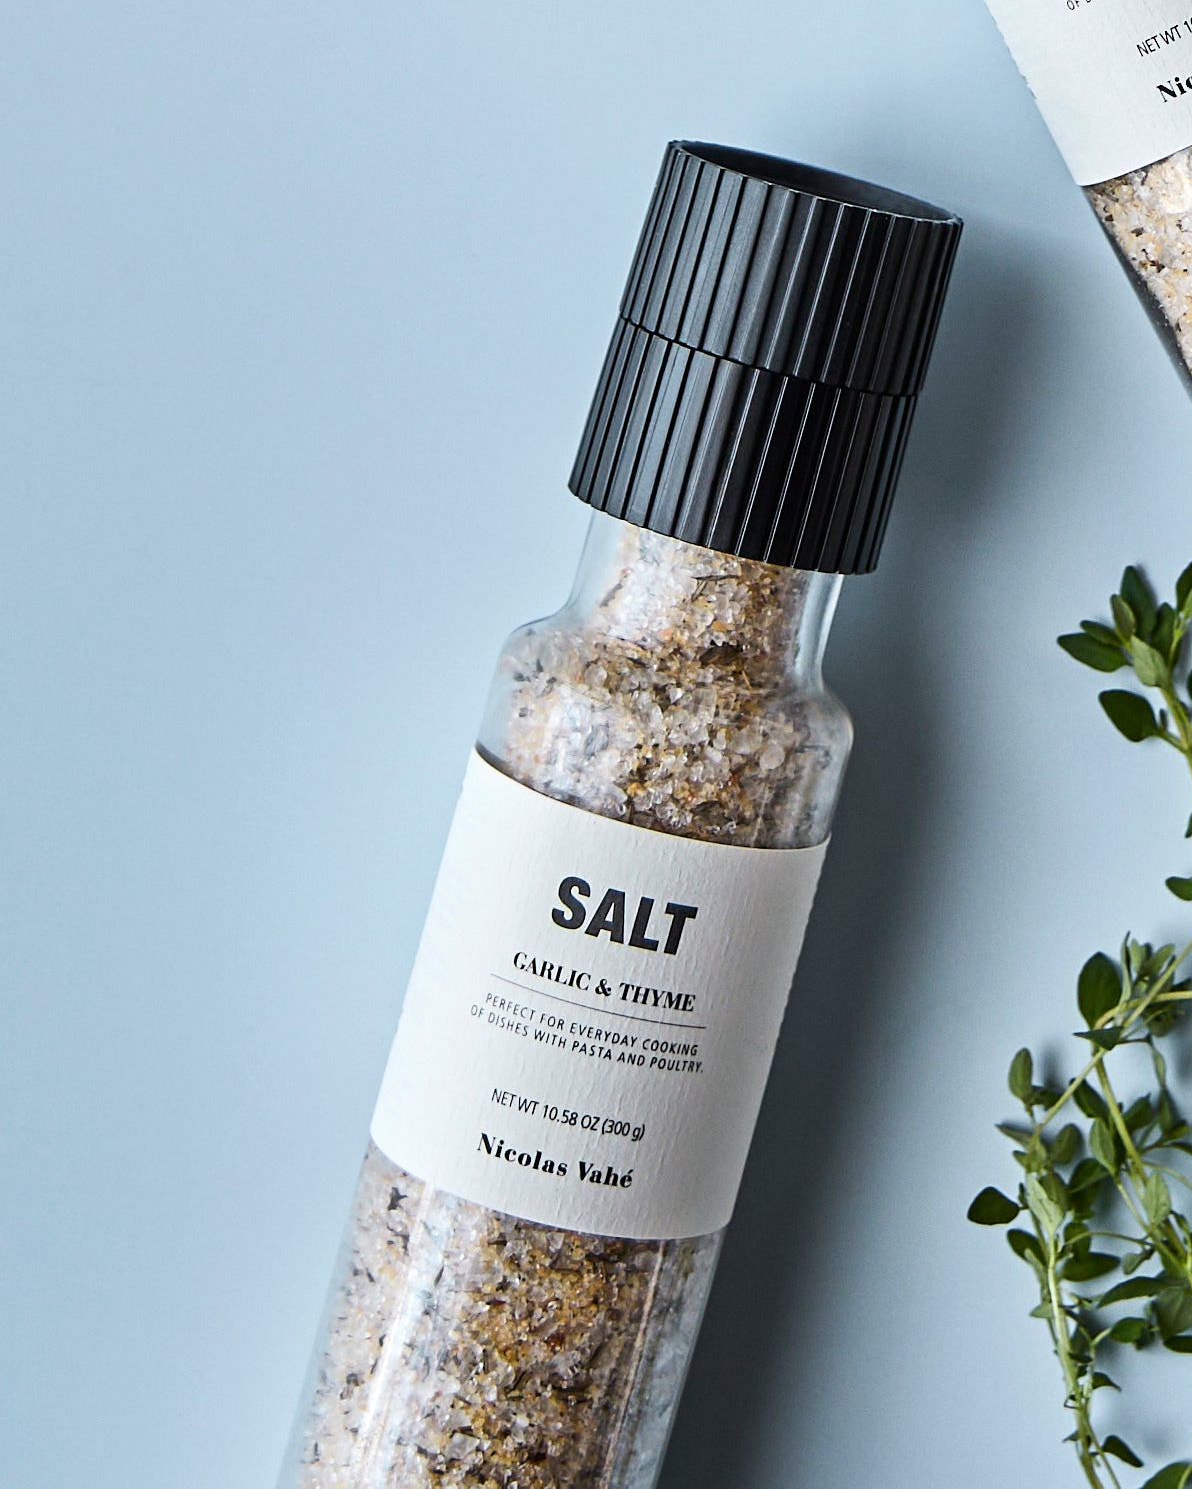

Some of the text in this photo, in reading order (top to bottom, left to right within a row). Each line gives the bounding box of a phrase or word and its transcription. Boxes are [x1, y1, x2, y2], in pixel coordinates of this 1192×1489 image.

[552, 877, 698, 955] SALT
[514, 952, 696, 1012] GARLIC & THYME
[471, 1005, 703, 1073] OF DISHES WITH PASTA AND POULTRY.
[486, 993, 698, 1056] PERFECT FOR EVERYDAY COOKING
[544, 1105, 578, 1126] 10.58
[581, 1115, 600, 1131] OZ
[478, 1133, 633, 1188] Nicolas Vahé
